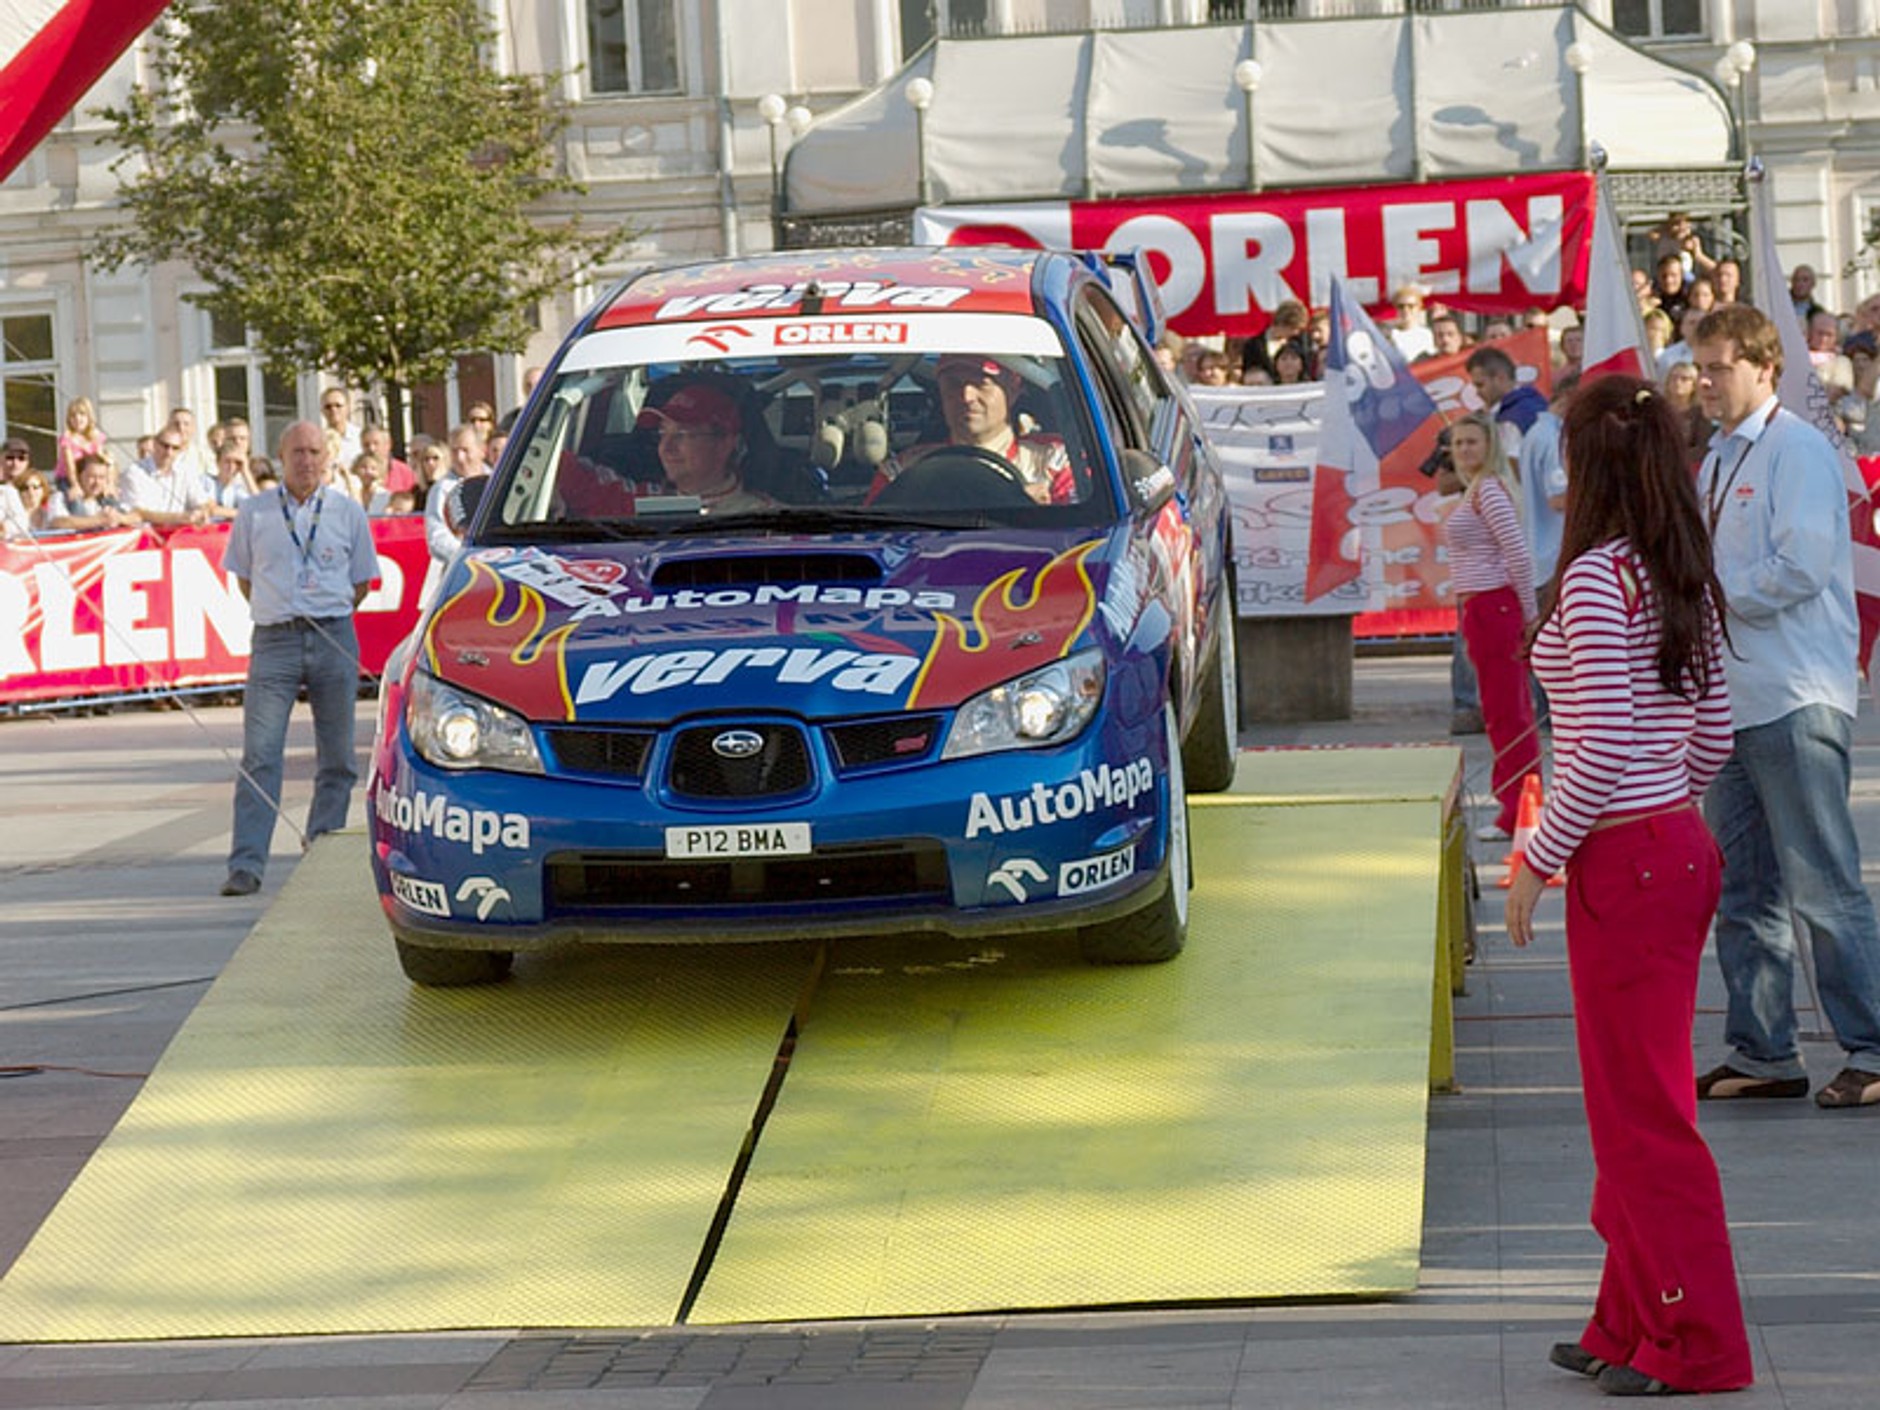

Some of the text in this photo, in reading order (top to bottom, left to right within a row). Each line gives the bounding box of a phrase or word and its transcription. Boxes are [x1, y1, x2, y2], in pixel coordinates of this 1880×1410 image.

[1106, 195, 1563, 318] ORLEN
[655, 281, 971, 319] verva
[779, 324, 899, 343] ORLEN
[569, 584, 954, 621] AutoMapa
[576, 647, 920, 704] verva
[965, 757, 1154, 838] AutoMapa
[686, 829, 787, 853] P12 BMA
[1066, 849, 1131, 890] ORLEN
